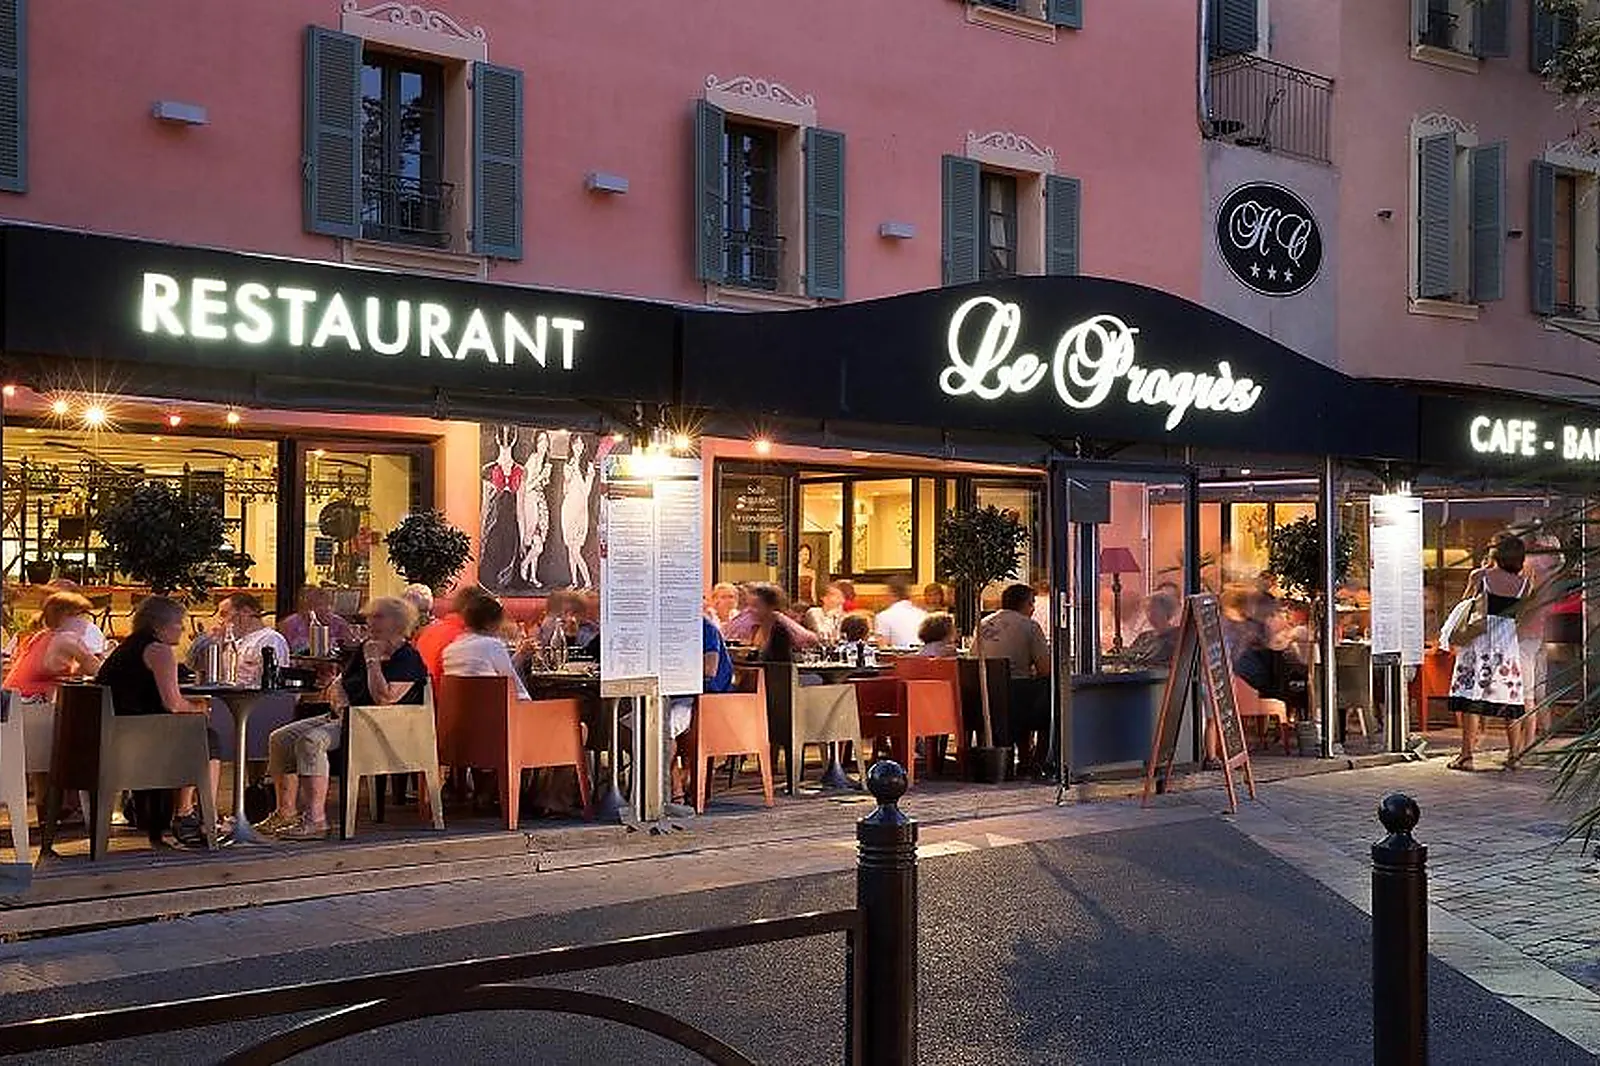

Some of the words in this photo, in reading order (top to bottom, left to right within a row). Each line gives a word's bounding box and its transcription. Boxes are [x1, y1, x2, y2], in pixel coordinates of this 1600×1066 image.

[141, 272, 584, 369] RESTAURANT
[939, 296, 1047, 399] Le
[1054, 315, 1262, 430] Progrès
[1471, 416, 1536, 455] CAFE
